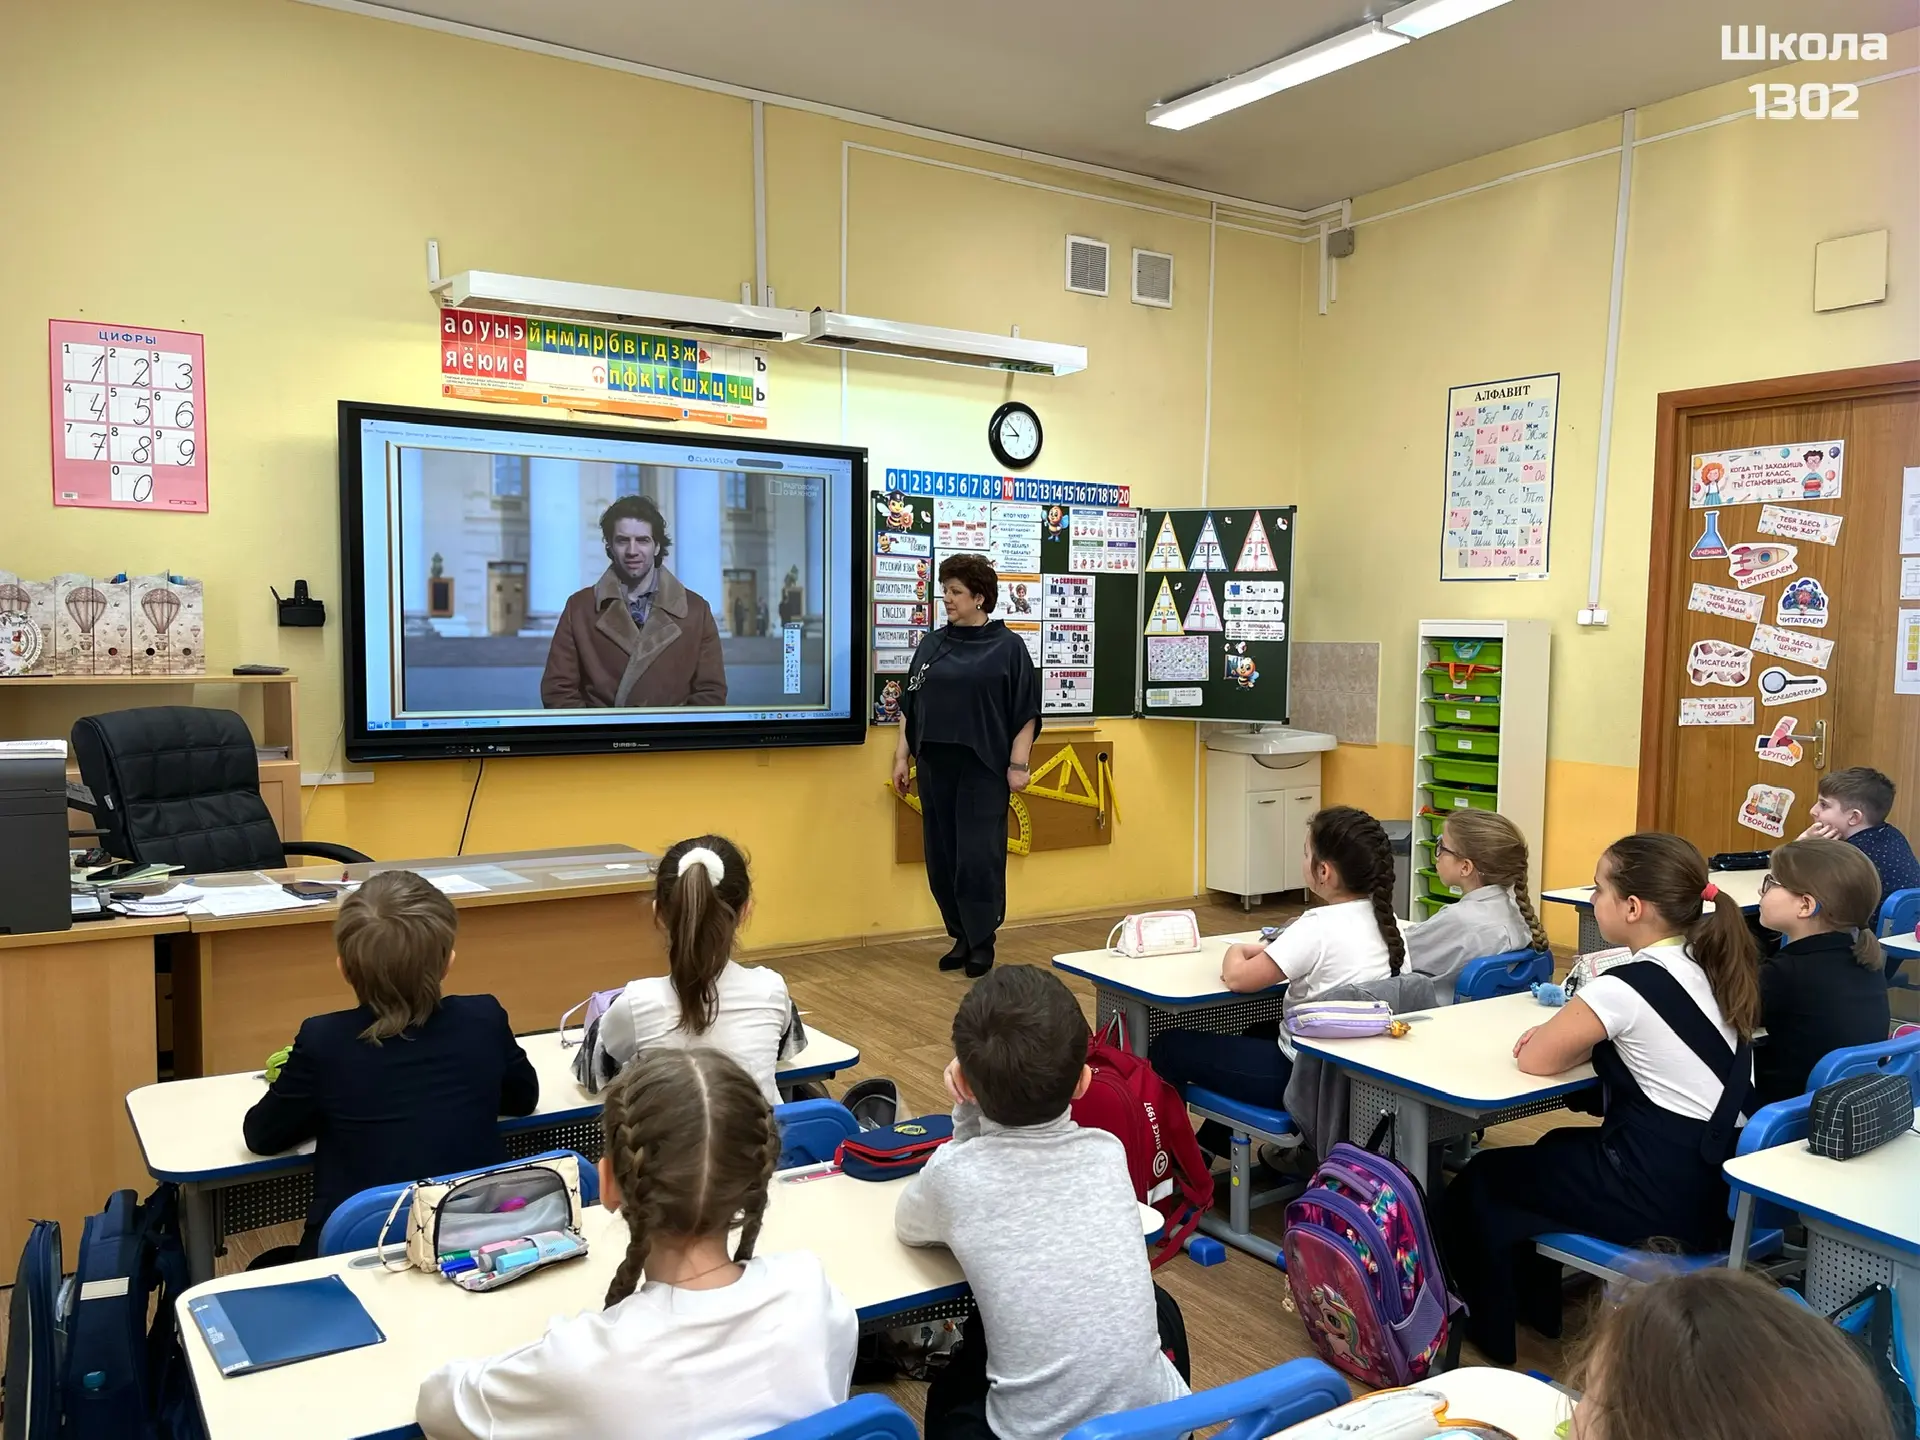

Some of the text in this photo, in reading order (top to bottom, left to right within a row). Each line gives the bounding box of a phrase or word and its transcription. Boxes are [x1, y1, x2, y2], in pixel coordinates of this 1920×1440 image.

[99, 331, 156, 344] ЦИФРЫ
[444, 317, 524, 342] а о у ы э
[530, 322, 604, 355] й н м л р
[64, 344, 160, 362] 1 2 3
[609, 333, 696, 362] б в г д з ж
[445, 347, 524, 374] я ё ю и е
[92, 355, 193, 390] 1 2 3
[64, 384, 161, 401] 4 5 6
[610, 366, 753, 402] п ф к т с ш х ц ч щ
[1475, 385, 1530, 402] АЛФАВИТ
[90, 394, 194, 428] 4 5 6
[66, 424, 162, 440] 7 8 9
[90, 432, 195, 466] 7 8 9
[112, 466, 120, 476] 0
[1765, 462, 1804, 470] ЗАХОДИШЬ
[133, 474, 152, 502] 0
[888, 472, 1128, 504] 0 1 2 3 4 5 6 7 8 9 10 11 12 13 14 15 16 17 18 19 20
[1776, 524, 1798, 532] ОЧЕНЬ
[1799, 519, 1820, 528] ЗДЕСЬ
[880, 560, 916, 572] РУССКИЙ ЯЗЫК
[1740, 564, 1794, 586] МЕЧТАТЕЛЕМ
[1706, 601, 1726, 610] ОЧЕНЬ
[1726, 598, 1746, 606] ЗДЕСЬ
[882, 606, 906, 618] ENGLISH
[878, 630, 908, 640] МАТЕМАТИКА
[1774, 634, 1812, 649] ТЕБЯ ЗДЕСЬ
[1696, 658, 1741, 668] ПИСАТЕЛЕМ
[1764, 686, 1822, 702] ИССЛЕДОВАТЕЛЕМ
[1761, 750, 1794, 762] ДРУГОМ
[1742, 814, 1780, 833] ТВОРЦОМ
[1143, 1102, 1162, 1150] SINCE 1997
